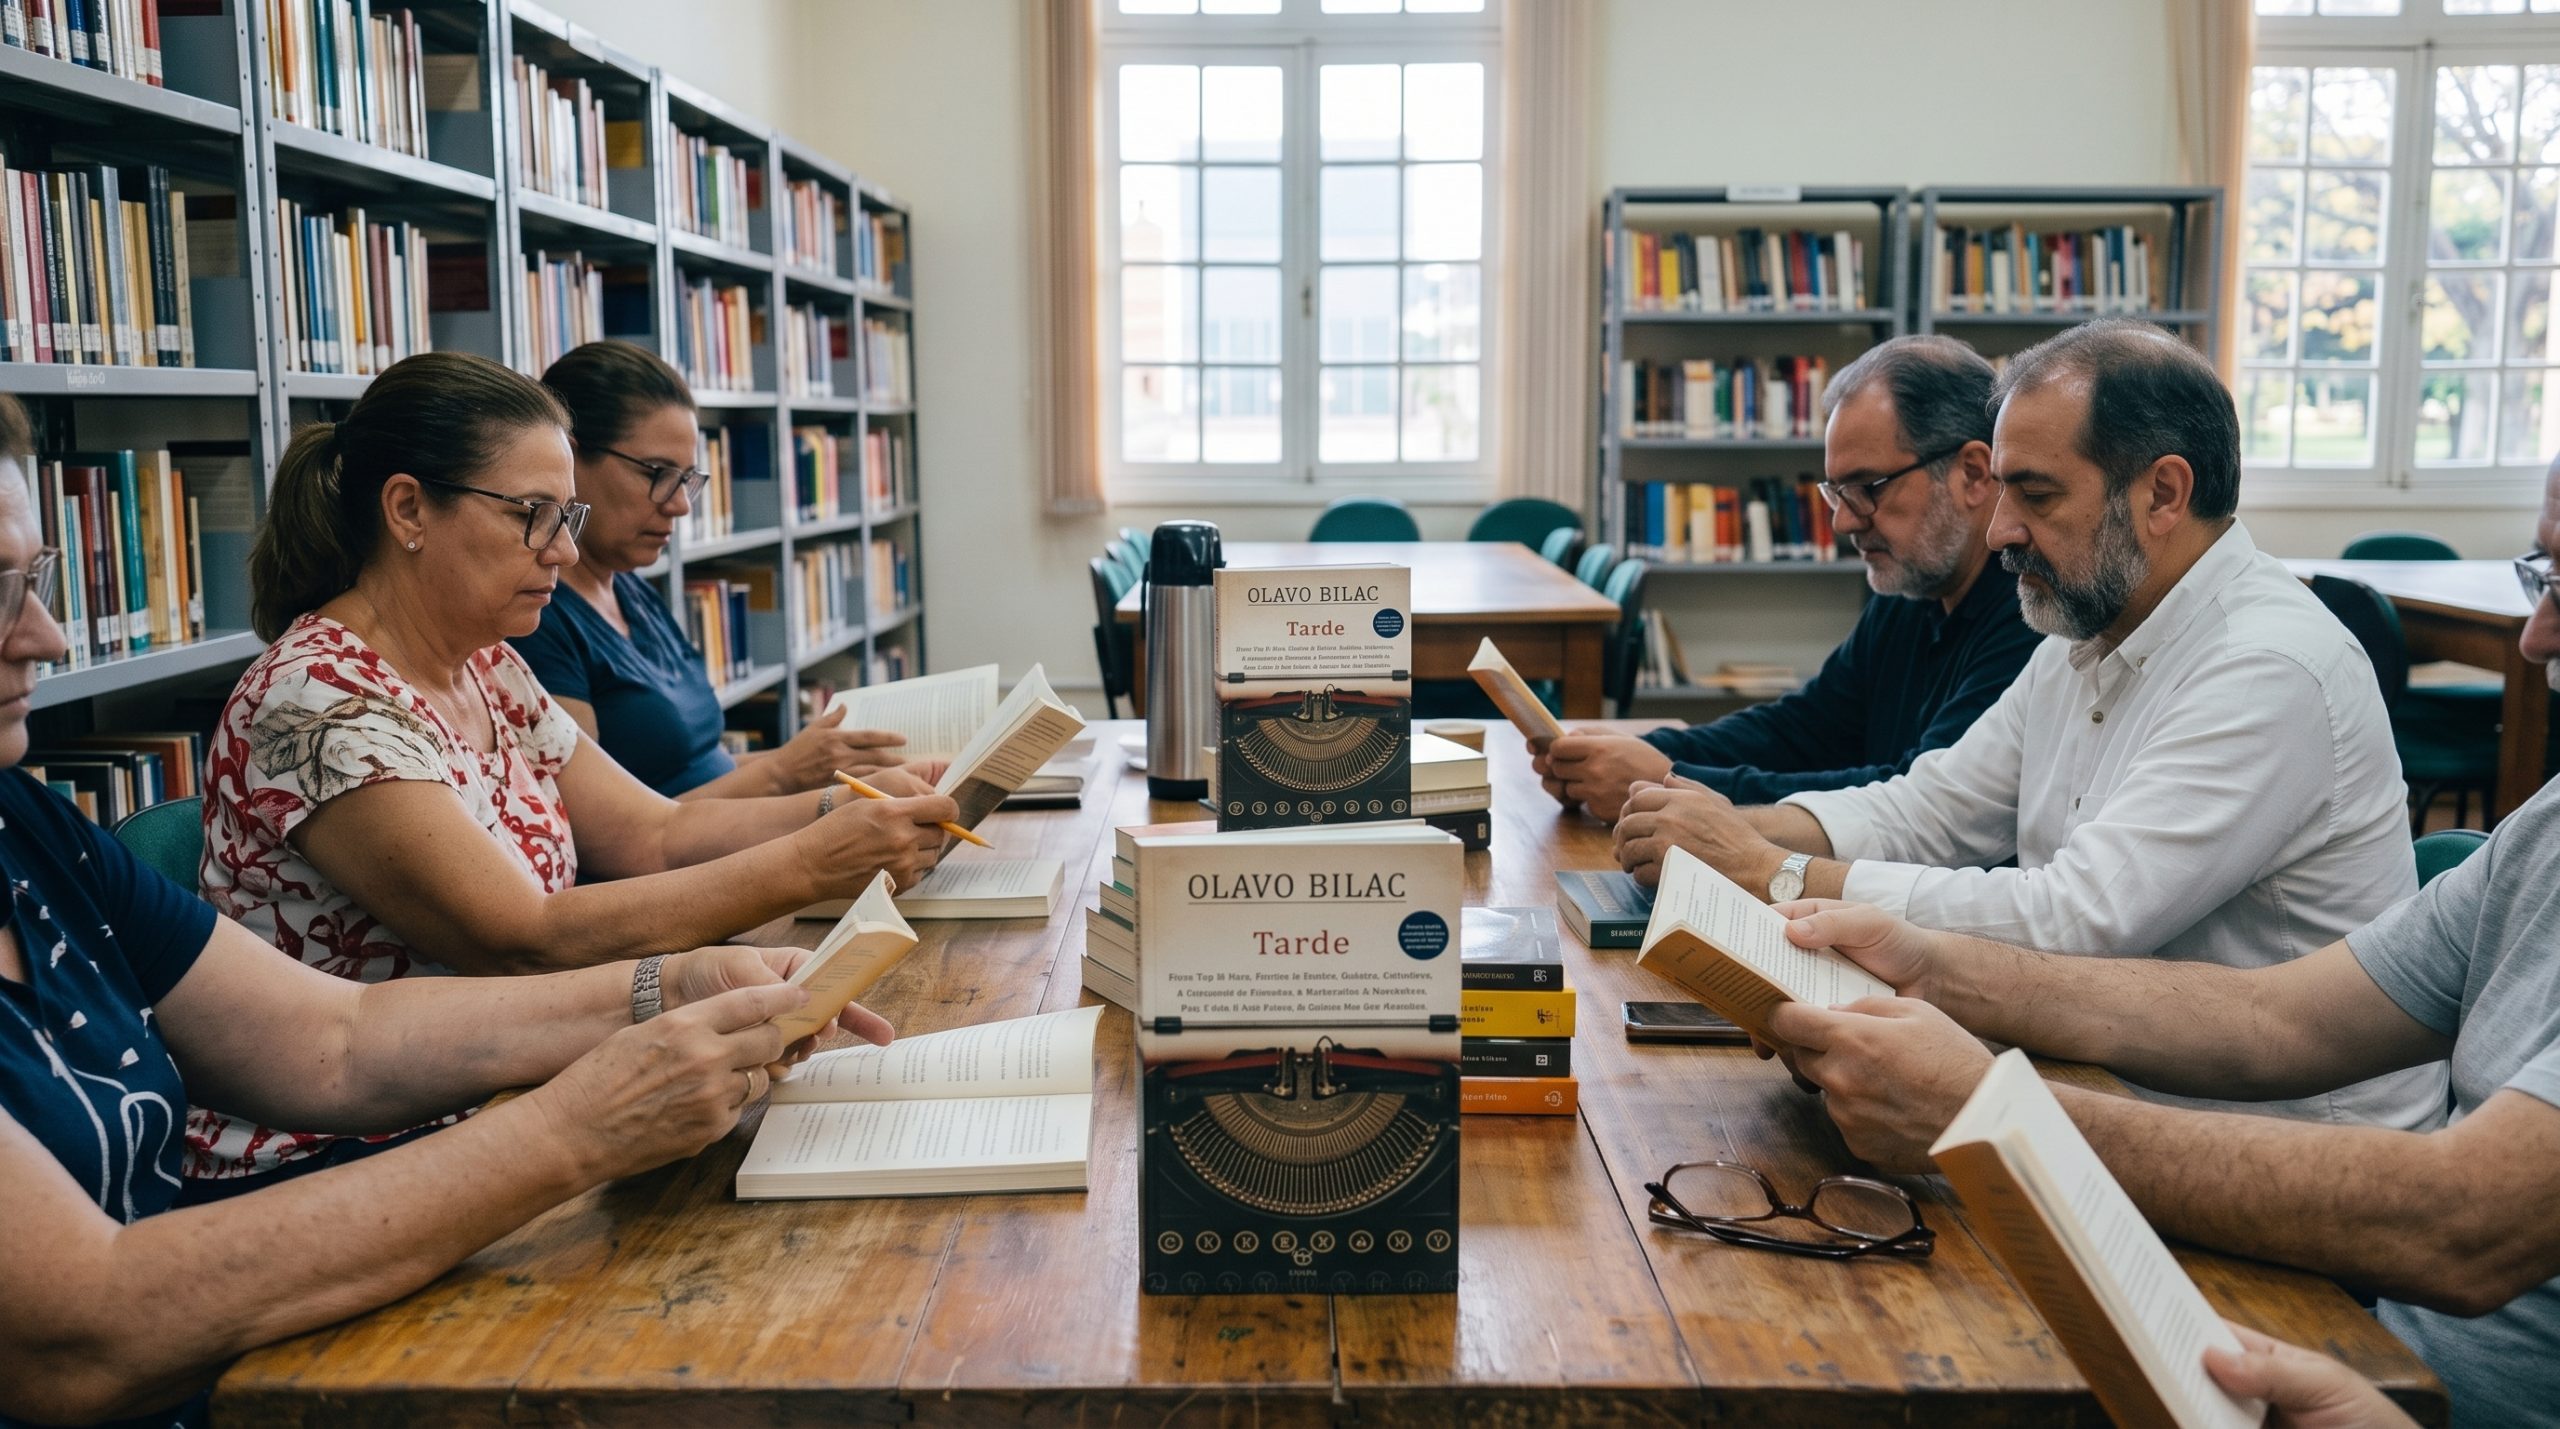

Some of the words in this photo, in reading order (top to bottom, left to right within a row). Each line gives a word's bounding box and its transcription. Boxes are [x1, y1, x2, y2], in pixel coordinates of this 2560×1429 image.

[1248, 586, 1312, 603] OLAVO
[1319, 585, 1379, 603] BILAC
[1286, 620, 1345, 637] Tarde
[1188, 873, 1294, 900] OLAVO
[1309, 872, 1406, 899] BILAC
[1252, 930, 1350, 956] Tarde
